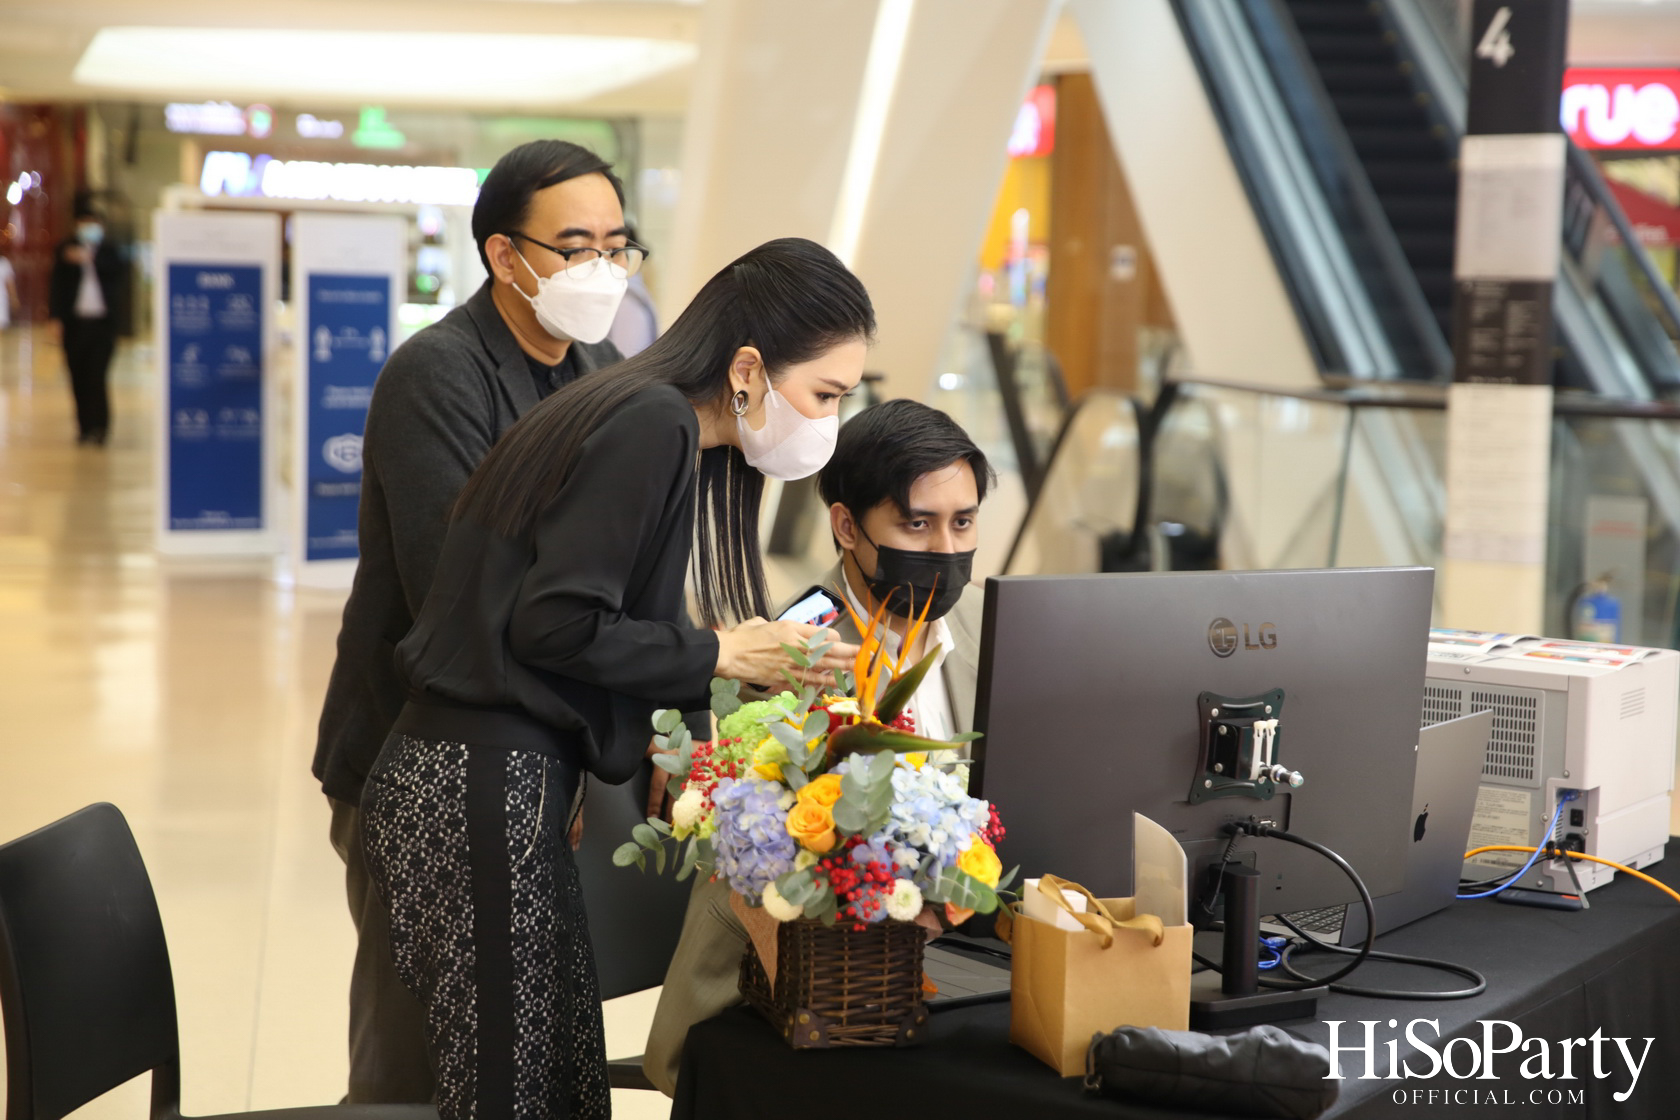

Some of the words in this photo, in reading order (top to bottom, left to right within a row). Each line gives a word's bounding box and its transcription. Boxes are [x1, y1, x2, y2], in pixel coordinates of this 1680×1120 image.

[1475, 6, 1515, 67] 4
[1561, 82, 1680, 145] rue
[1243, 622, 1277, 650] LG
